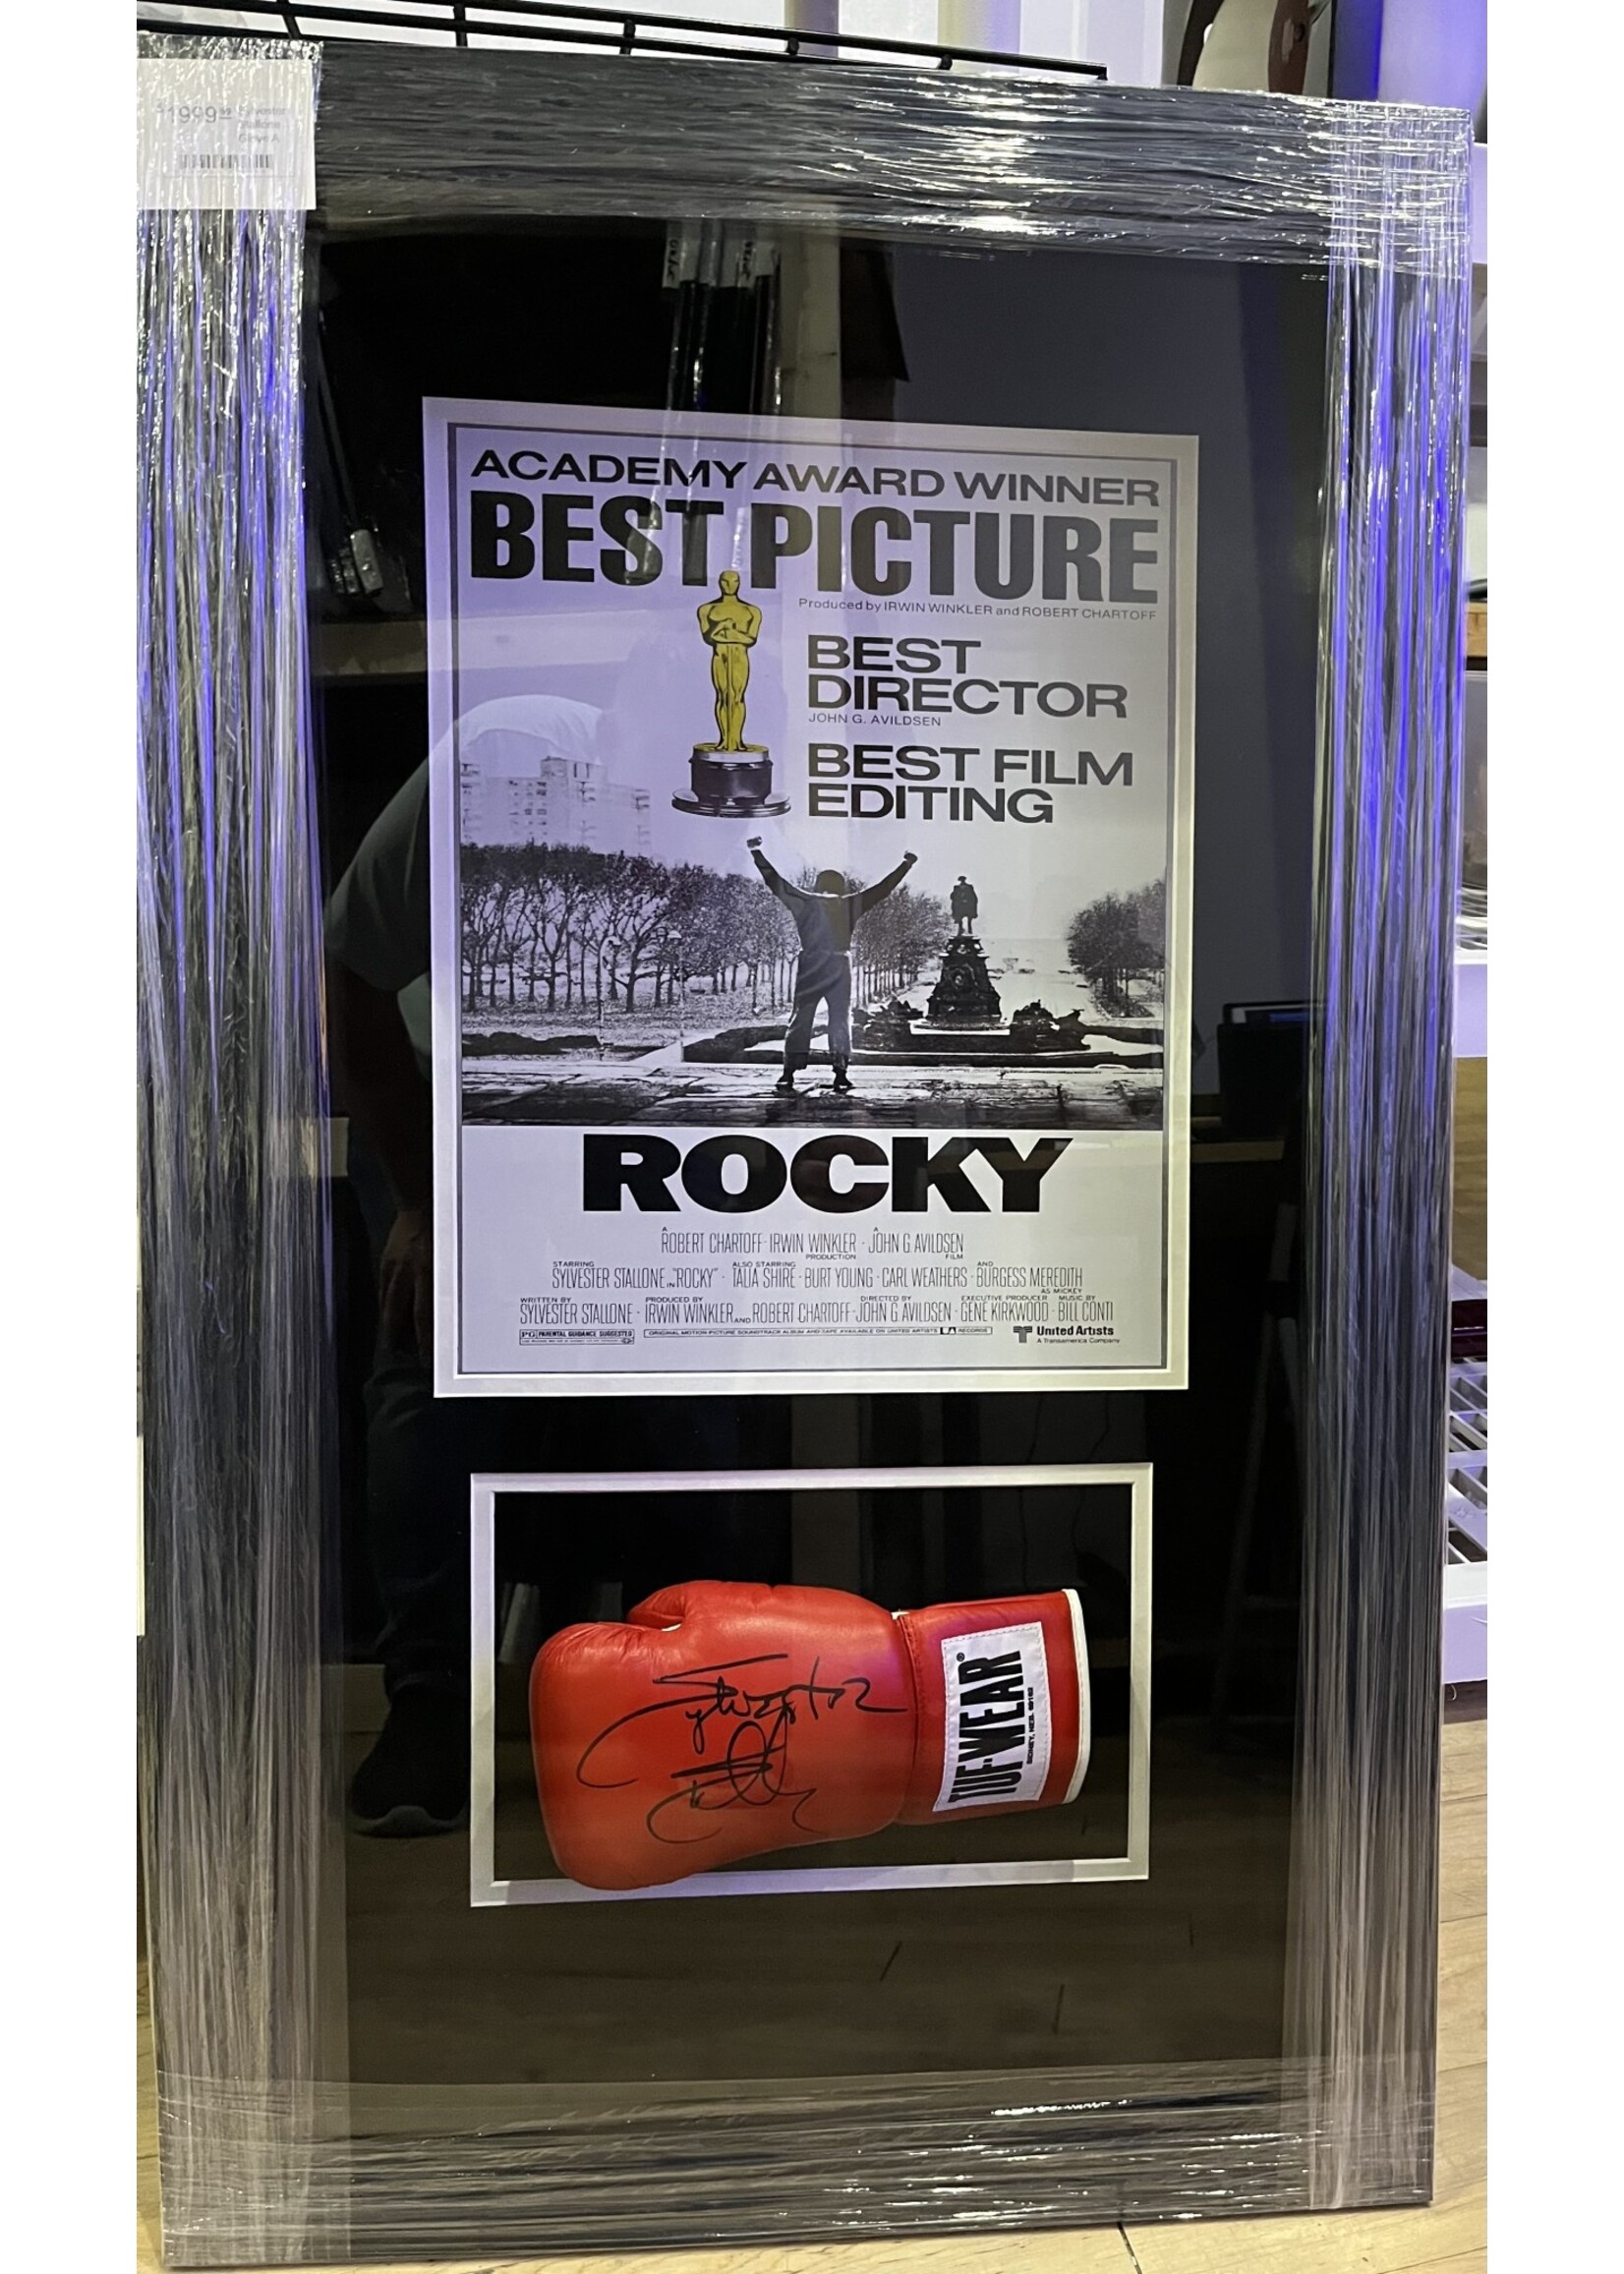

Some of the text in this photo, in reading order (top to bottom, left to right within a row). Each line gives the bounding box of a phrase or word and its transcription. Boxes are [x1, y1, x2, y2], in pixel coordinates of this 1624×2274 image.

[470, 449, 1161, 507] ACADEMY AWARD WINNER
[470, 490, 1159, 604] BEST PICTURE
[798, 598, 1157, 620] Produced by IRWIN WINKLER and ROBERT CHARTOFF
[808, 634, 981, 674] BEST
[808, 673, 1128, 720] DIRECTOR
[808, 713, 942, 727] JOHN G. AVILDSEN
[808, 742, 1133, 787] BEST FILM
[808, 783, 1053, 824] EDITING
[583, 1134, 1074, 1213] ROCKY
[662, 1233, 857, 1254] ROBERT CHARTOFF IRWIN WINKLER
[868, 1233, 899, 1254] JOHN
[914, 1233, 963, 1254] AVILDSEN
[552, 1267, 609, 1289] SYLVESTER
[614, 1267, 666, 1289] STALLONE
[763, 1267, 796, 1289] SHIRE
[804, 1266, 874, 1288] BURT YOUNG
[882, 1266, 968, 1288] CARL WEATHERS
[976, 1266, 1083, 1288] BURGESS MEREDITH
[520, 1303, 633, 1324] SYLVESTER STALLONE
[645, 1303, 680, 1324] IRWIN
[683, 1303, 733, 1324] WINKLER
[752, 1302, 794, 1323] ROBERT
[798, 1302, 851, 1323] CHARTOFF
[856, 1302, 887, 1322] JOHN
[901, 1302, 952, 1322] AVILDSEN
[960, 1301, 1049, 1322] GENE KIRKWOOD
[1058, 1301, 1114, 1321] BILL CONTI
[1037, 1325, 1115, 1335] United Artists
